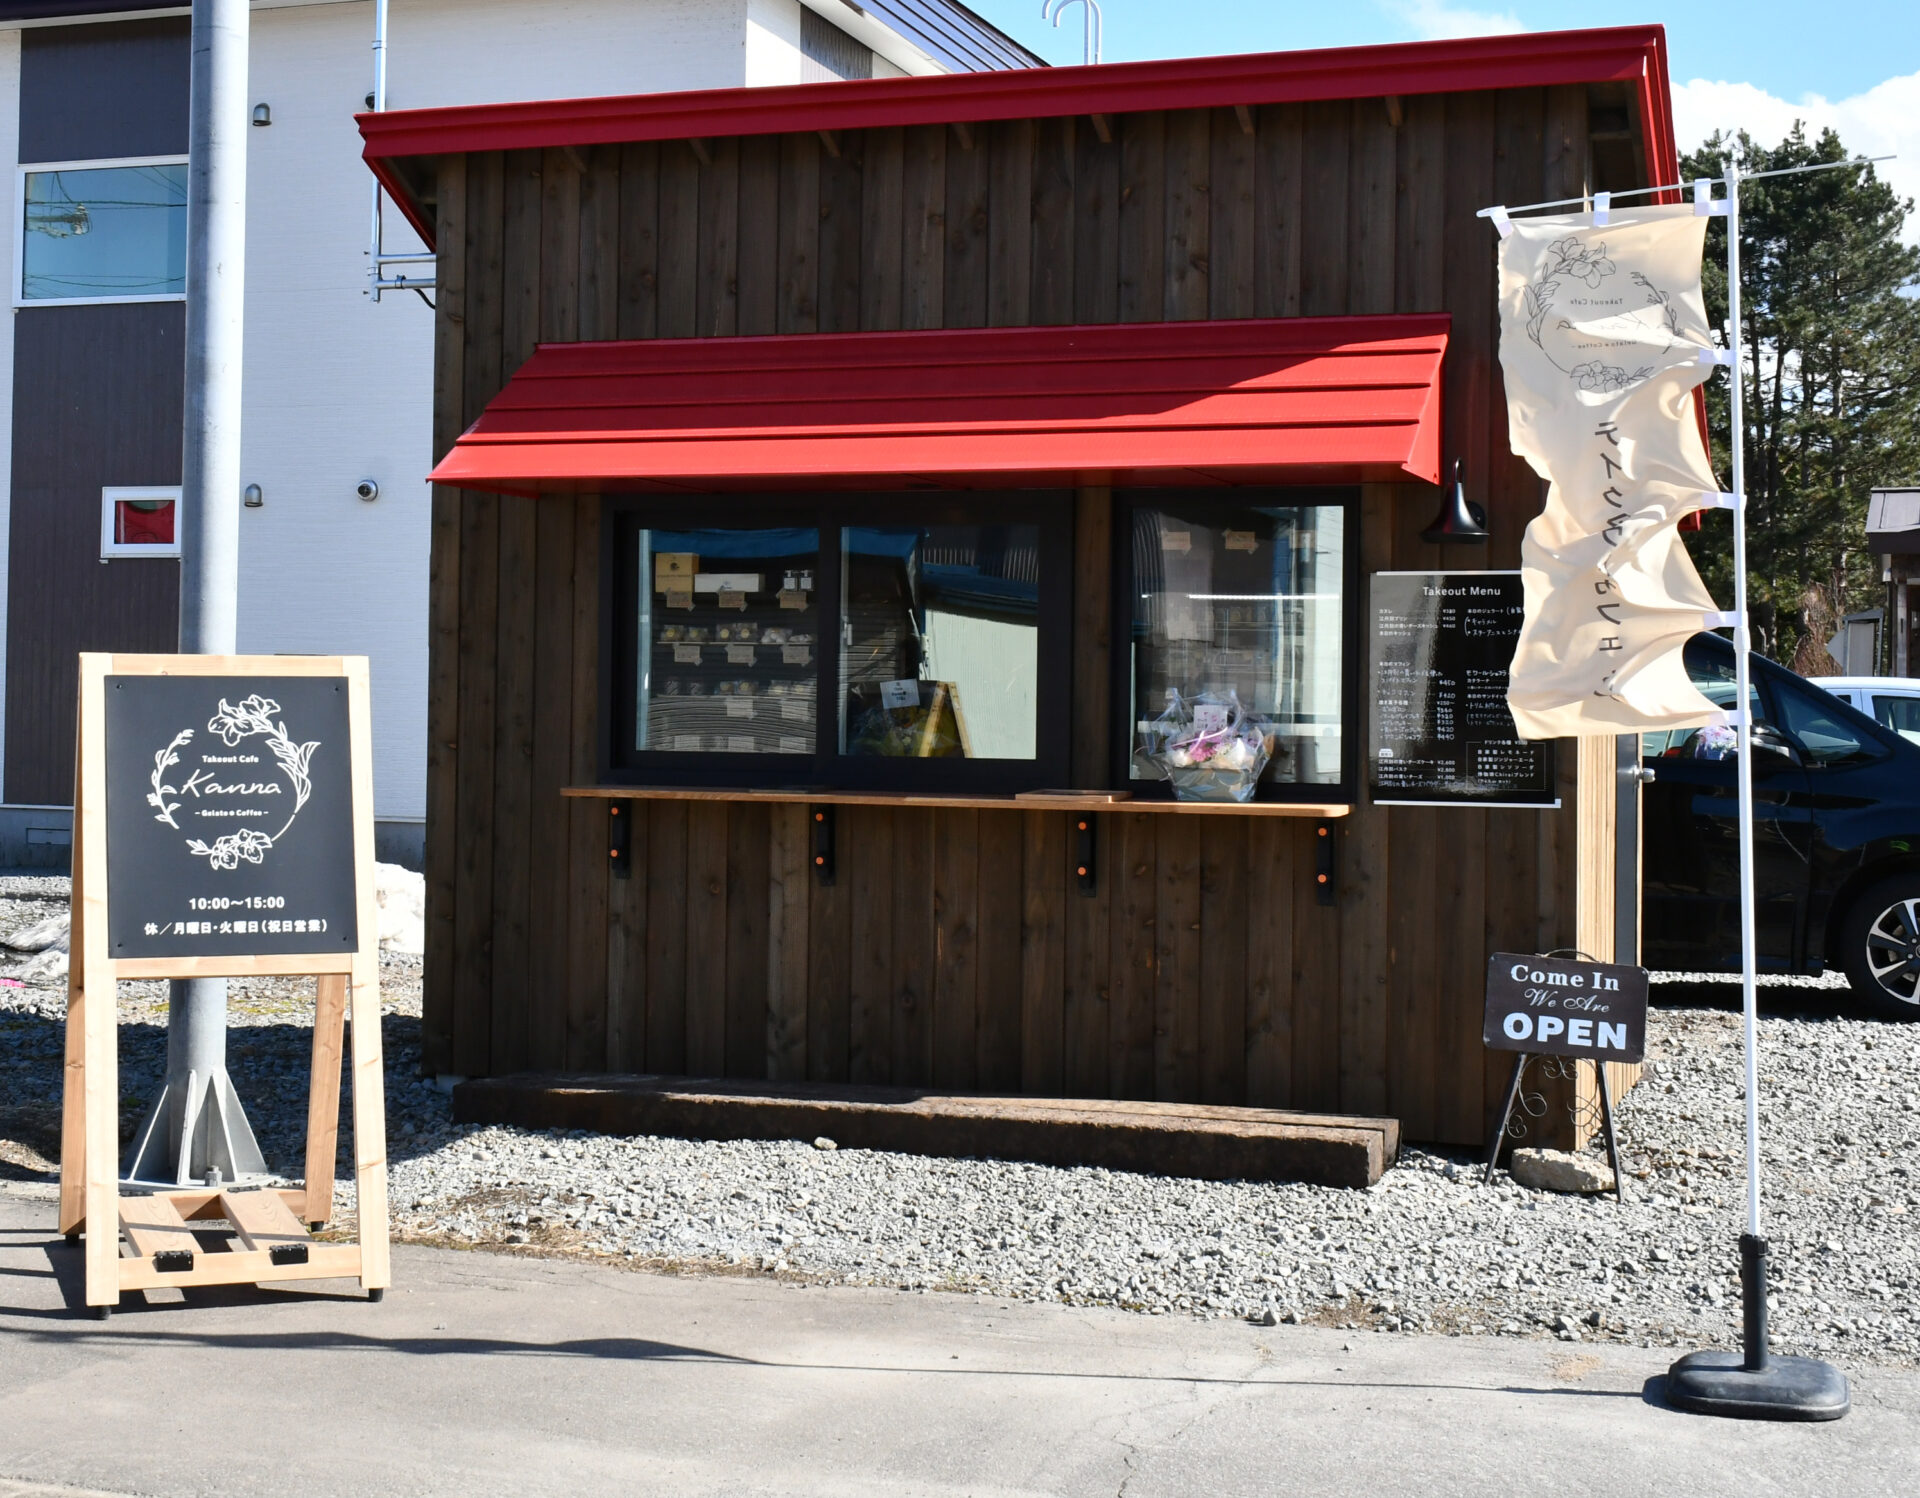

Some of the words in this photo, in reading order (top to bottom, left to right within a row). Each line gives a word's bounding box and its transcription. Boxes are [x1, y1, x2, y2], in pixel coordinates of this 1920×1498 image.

[1422, 586, 1467, 596] Takeout
[1469, 586, 1501, 596] Menu
[202, 755, 237, 763] Takeout
[238, 755, 259, 763] Cafe
[180, 769, 282, 798] Kanna
[236, 809, 262, 817] Coffee
[1510, 964, 1585, 987] Come
[1592, 972, 1620, 991] In
[1524, 988, 1558, 1008] We
[1563, 994, 1610, 1013] Are
[1503, 1012, 1627, 1050] OPEN
